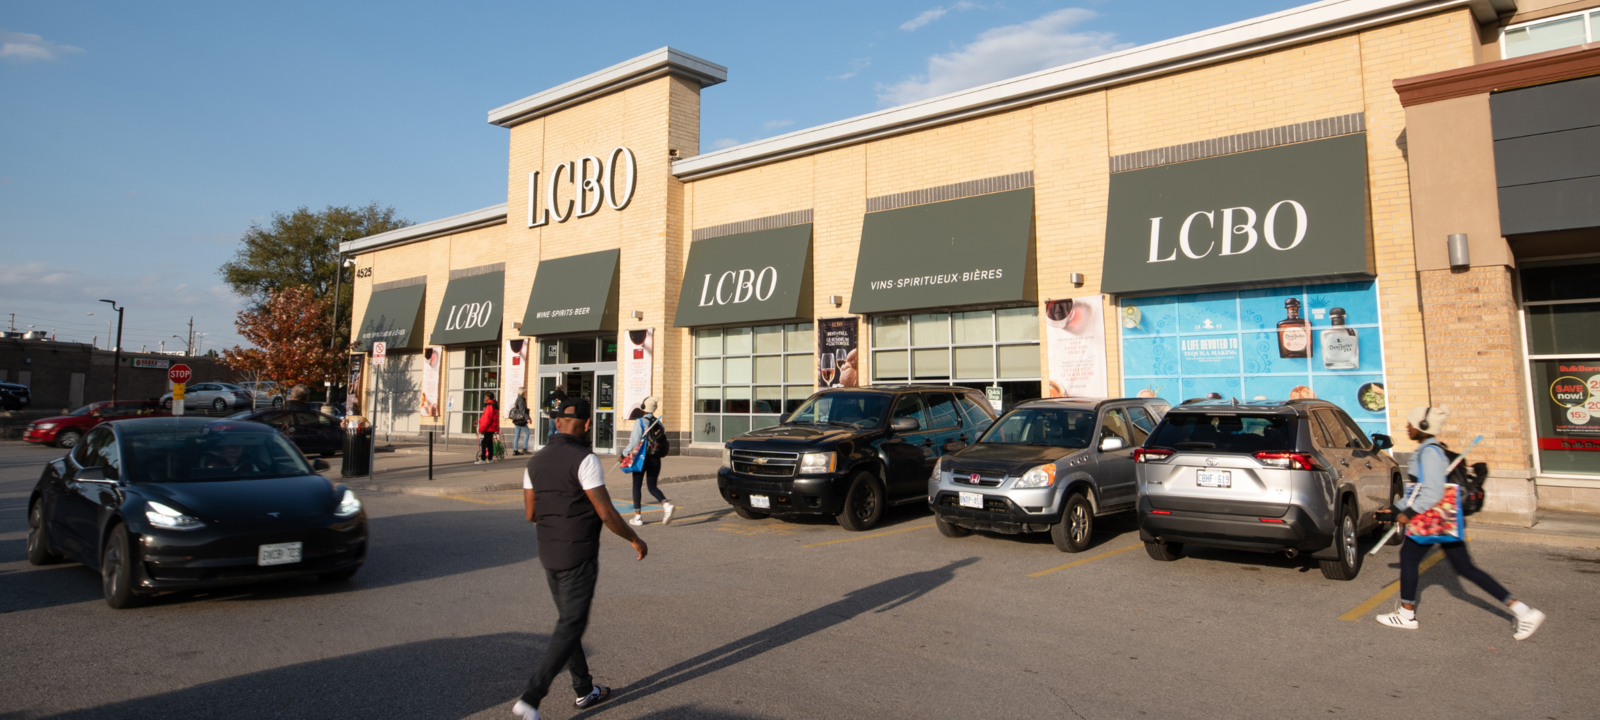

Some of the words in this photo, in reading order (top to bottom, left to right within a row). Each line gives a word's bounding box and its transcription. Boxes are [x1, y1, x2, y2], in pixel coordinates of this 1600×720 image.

[526, 146, 637, 229] LCBO
[1146, 199, 1308, 263] LCBO
[356, 267, 372, 278] 4525
[698, 266, 778, 307] LCBO
[444, 300, 492, 331] LCBO
[1181, 340, 1186, 351] A
[1187, 339, 1199, 351] LIFE
[1200, 338, 1228, 350] DEVOTED
[1229, 337, 1238, 349] TO
[170, 370, 190, 378] STOP
[1590, 380, 1600, 389] 2
[1557, 392, 1583, 400] now!
